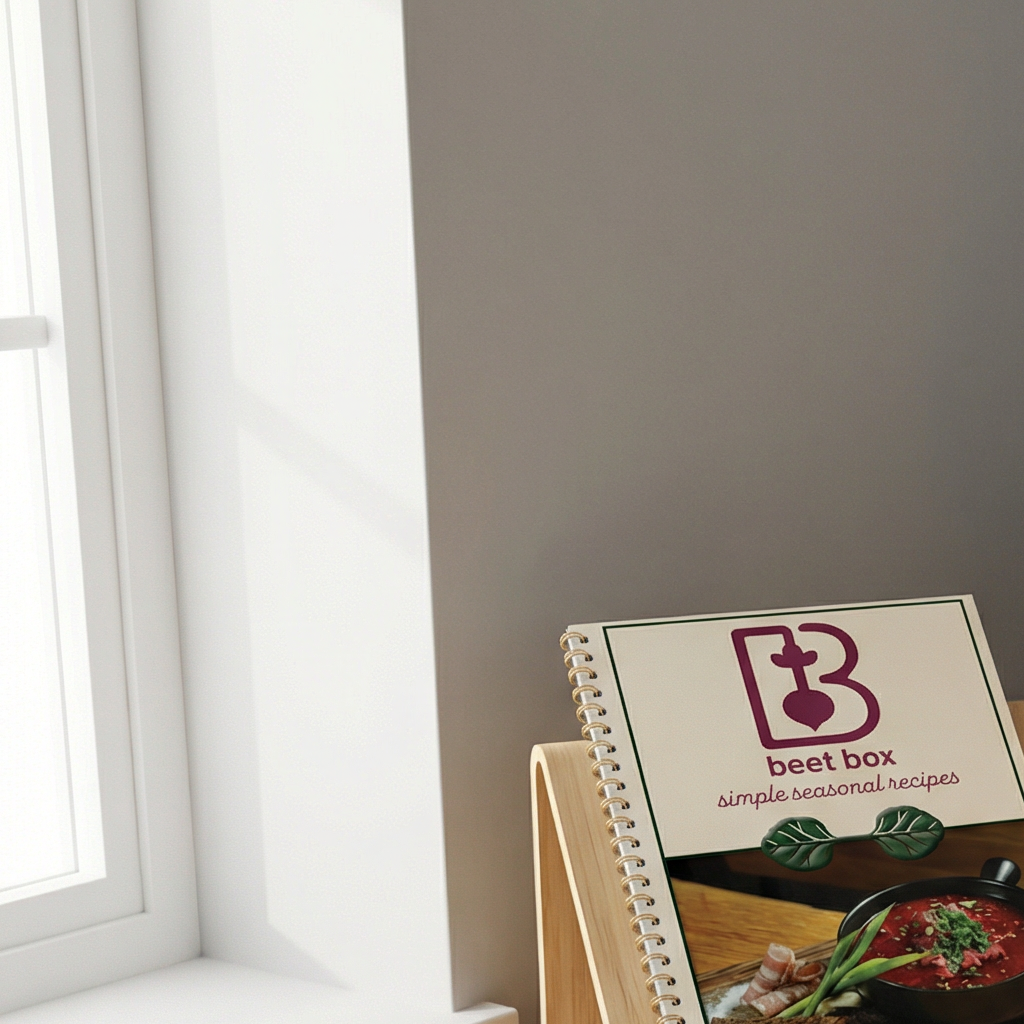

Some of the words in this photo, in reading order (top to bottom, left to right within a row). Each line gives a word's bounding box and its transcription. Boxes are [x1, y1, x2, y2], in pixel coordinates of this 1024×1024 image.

[766, 751, 837, 777] beet
[841, 749, 897, 770] box
[717, 784, 789, 810] simple
[791, 773, 885, 801] seasonal
[888, 771, 961, 793] recipes
